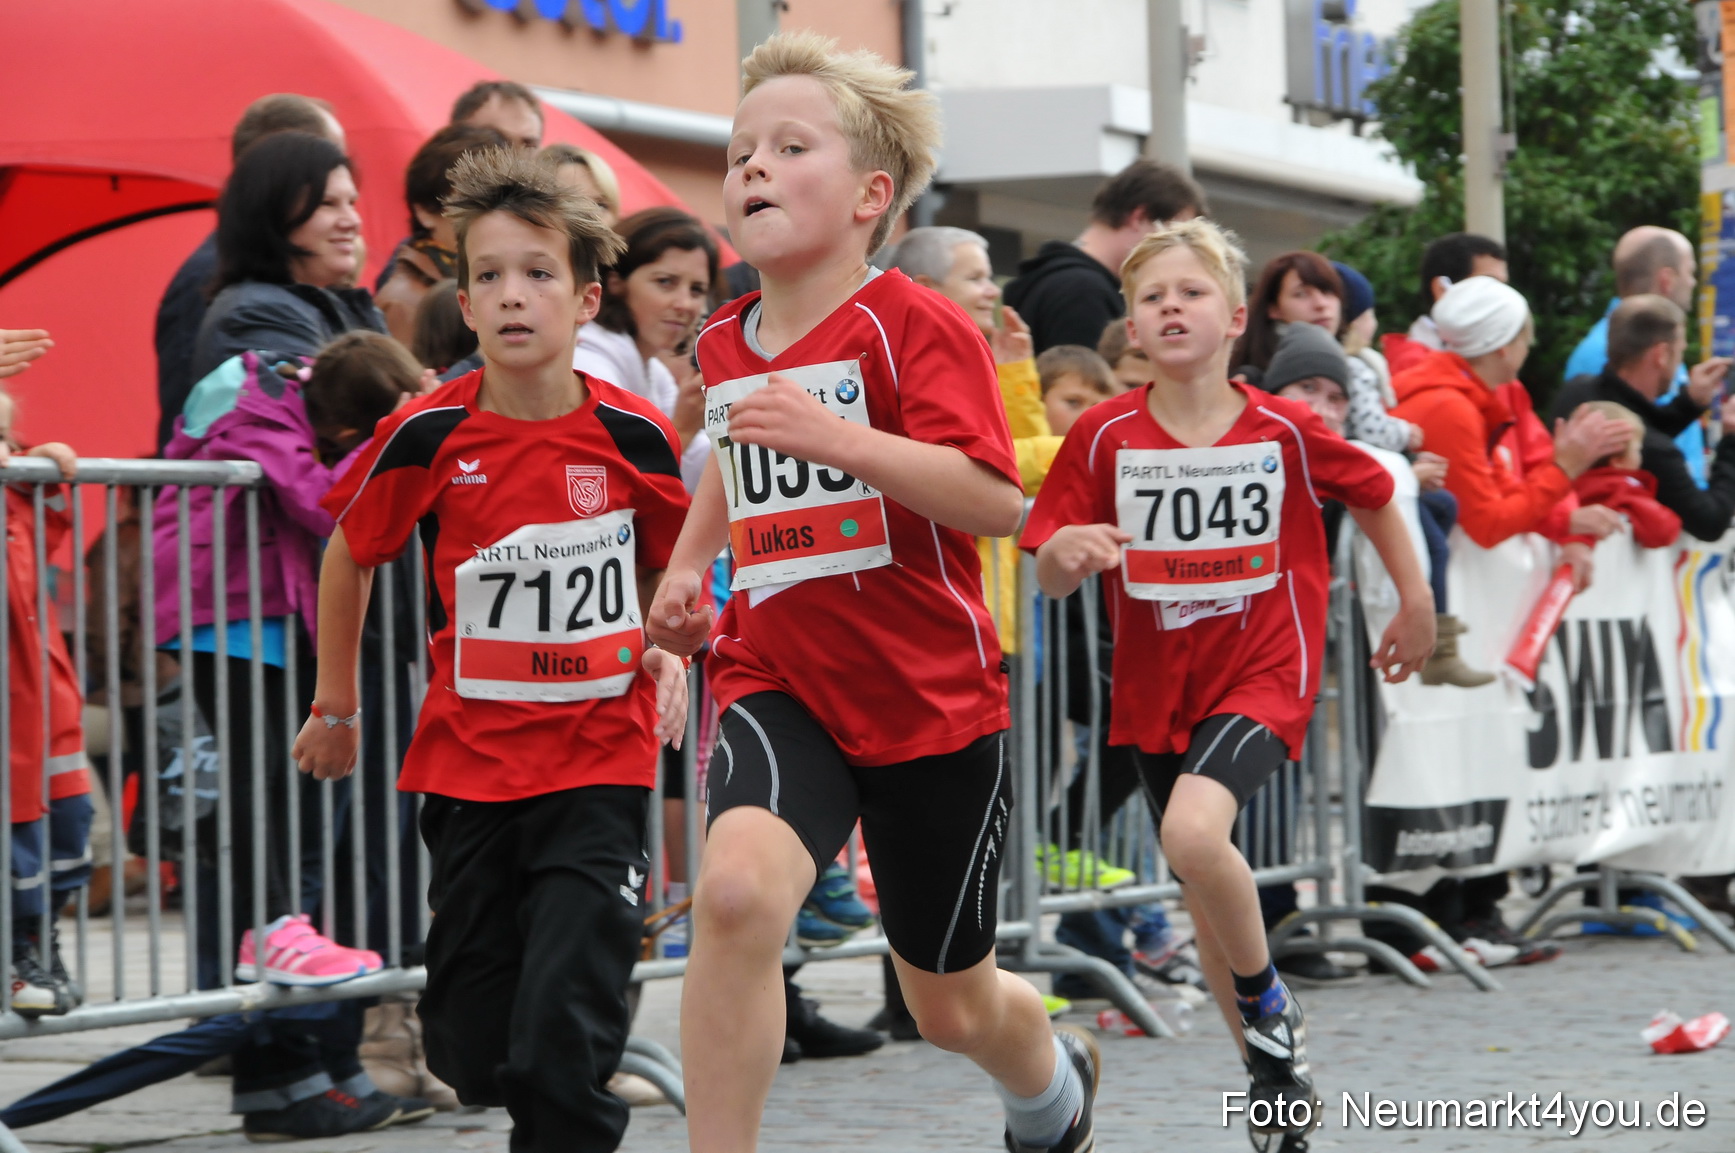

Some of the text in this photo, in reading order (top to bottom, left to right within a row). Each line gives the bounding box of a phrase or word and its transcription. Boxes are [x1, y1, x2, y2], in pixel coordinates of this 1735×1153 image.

[708, 401, 734, 427] PART
[1121, 460, 1256, 480] PARTL Neumarkt
[1135, 481, 1270, 542] 7043
[534, 534, 613, 560] Neumarkt
[748, 523, 815, 556] Lukas
[1164, 555, 1244, 579] Vincent
[479, 557, 624, 632] 7120
[531, 651, 589, 676] Nico
